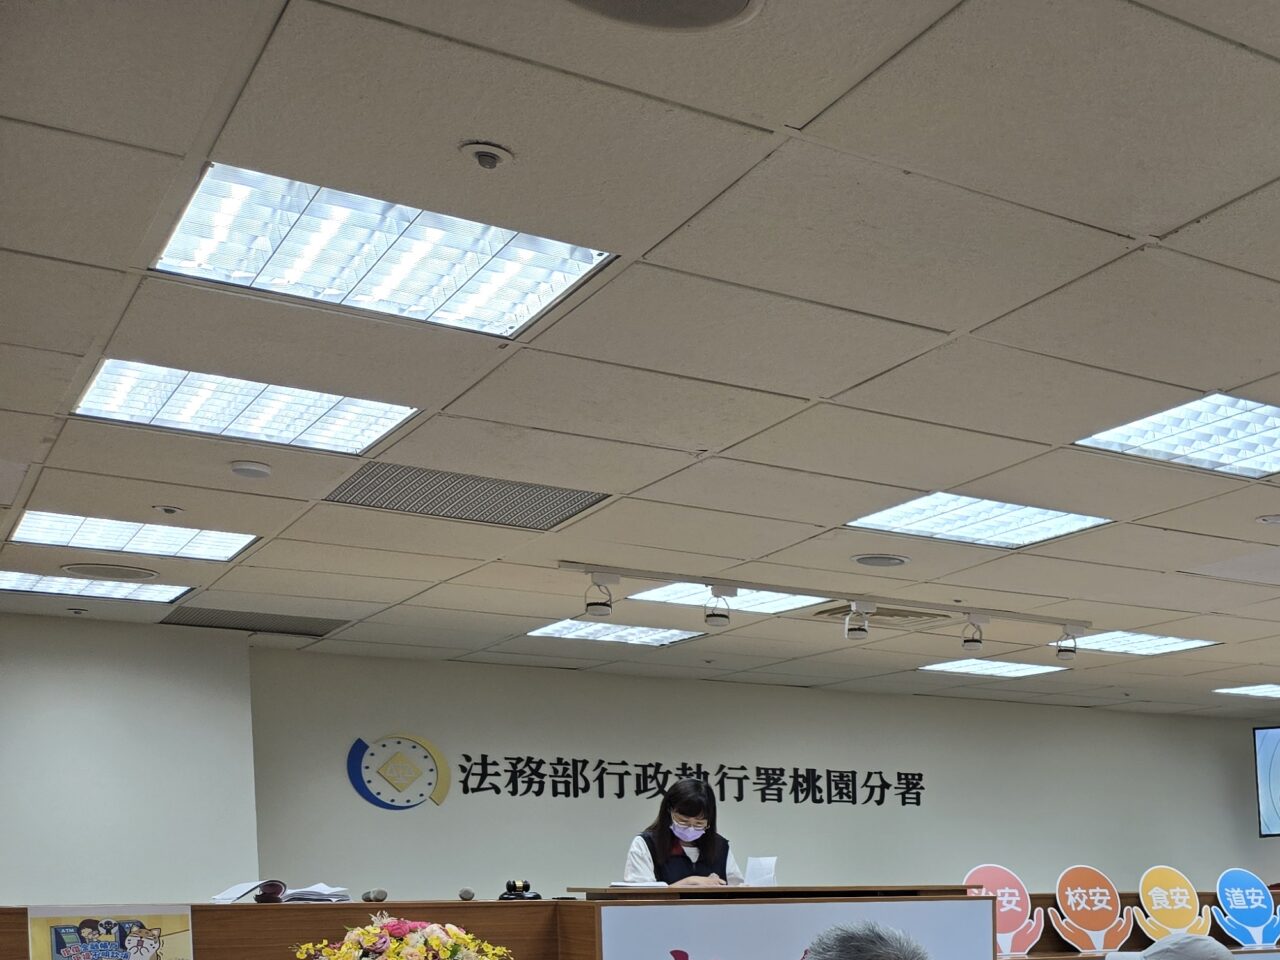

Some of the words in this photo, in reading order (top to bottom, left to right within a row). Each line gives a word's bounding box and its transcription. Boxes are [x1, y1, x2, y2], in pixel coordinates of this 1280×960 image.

[1065, 887, 1112, 912] 校安
[1148, 886, 1193, 911] 食安
[1225, 887, 1268, 910] 道安
